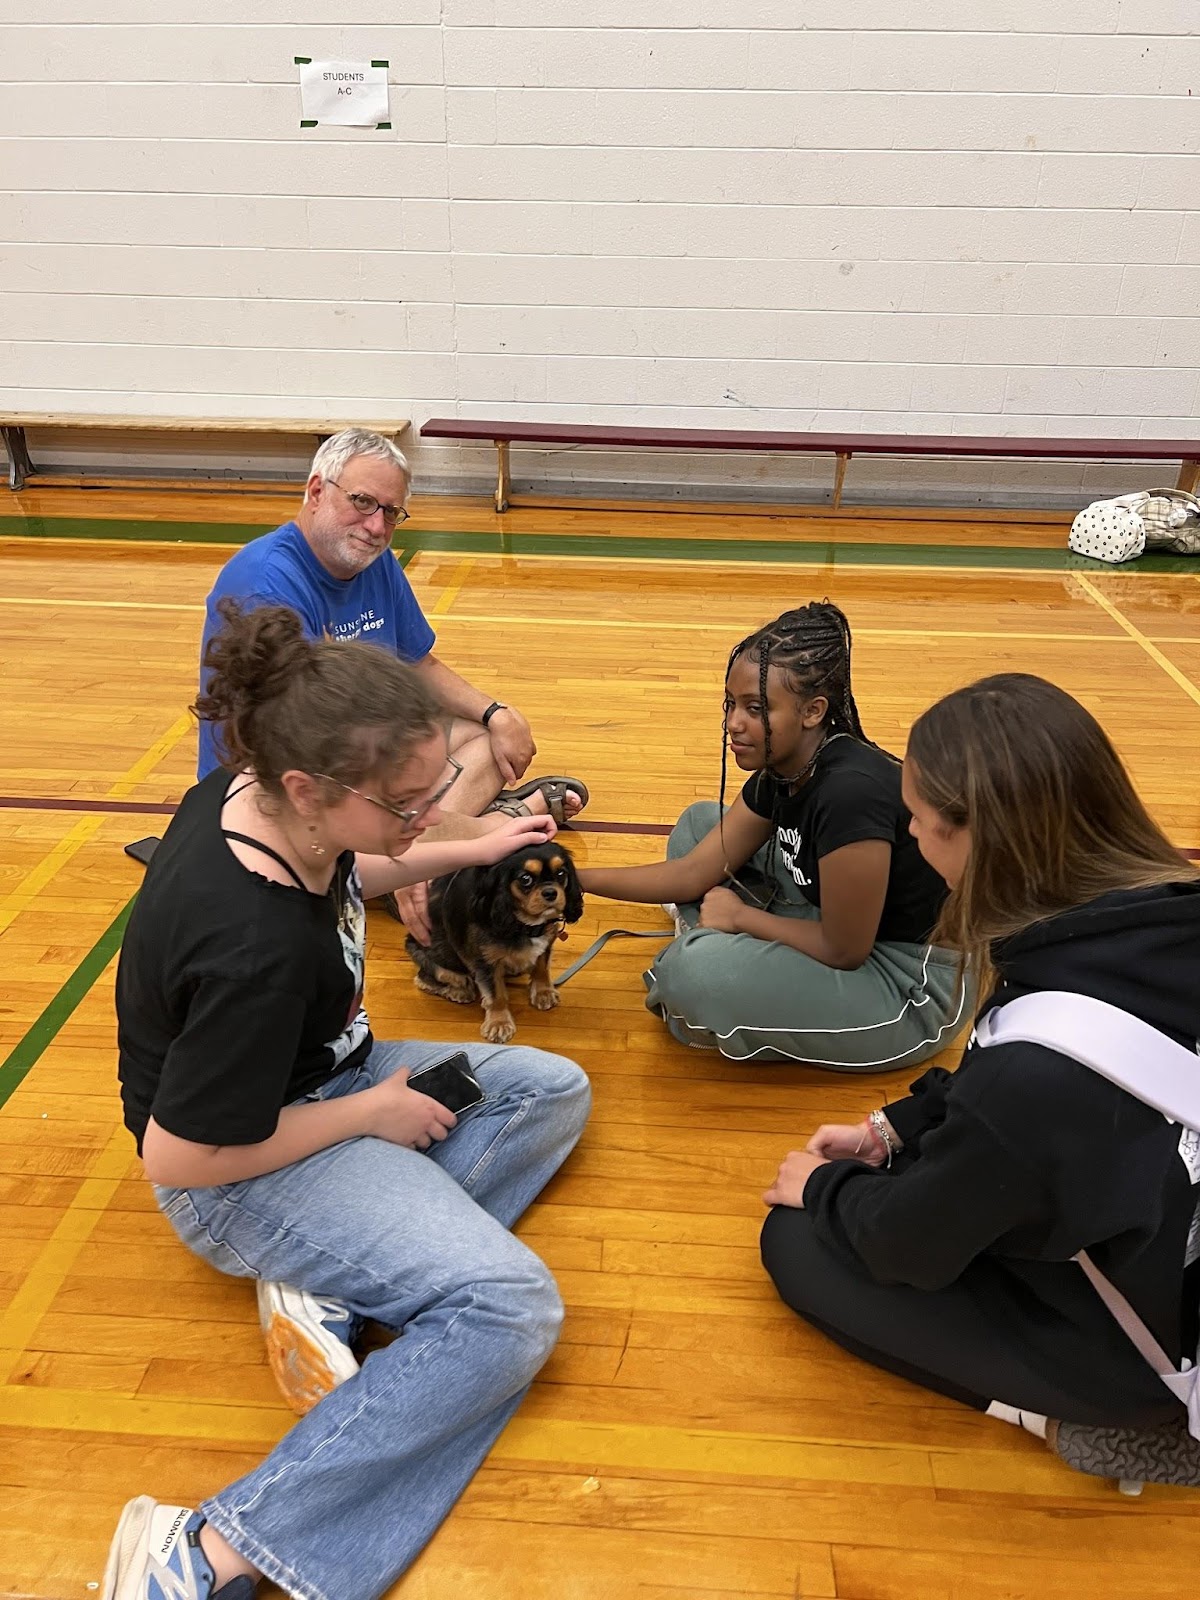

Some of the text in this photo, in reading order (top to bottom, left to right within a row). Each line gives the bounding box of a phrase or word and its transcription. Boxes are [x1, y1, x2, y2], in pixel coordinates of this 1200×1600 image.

[322, 72, 365, 82] STUDENTS
[337, 87, 353, 96] A-C
[334, 609, 375, 635] SUNSNE
[362, 617, 385, 632] dogs
[161, 1508, 190, 1554] SALOMON
